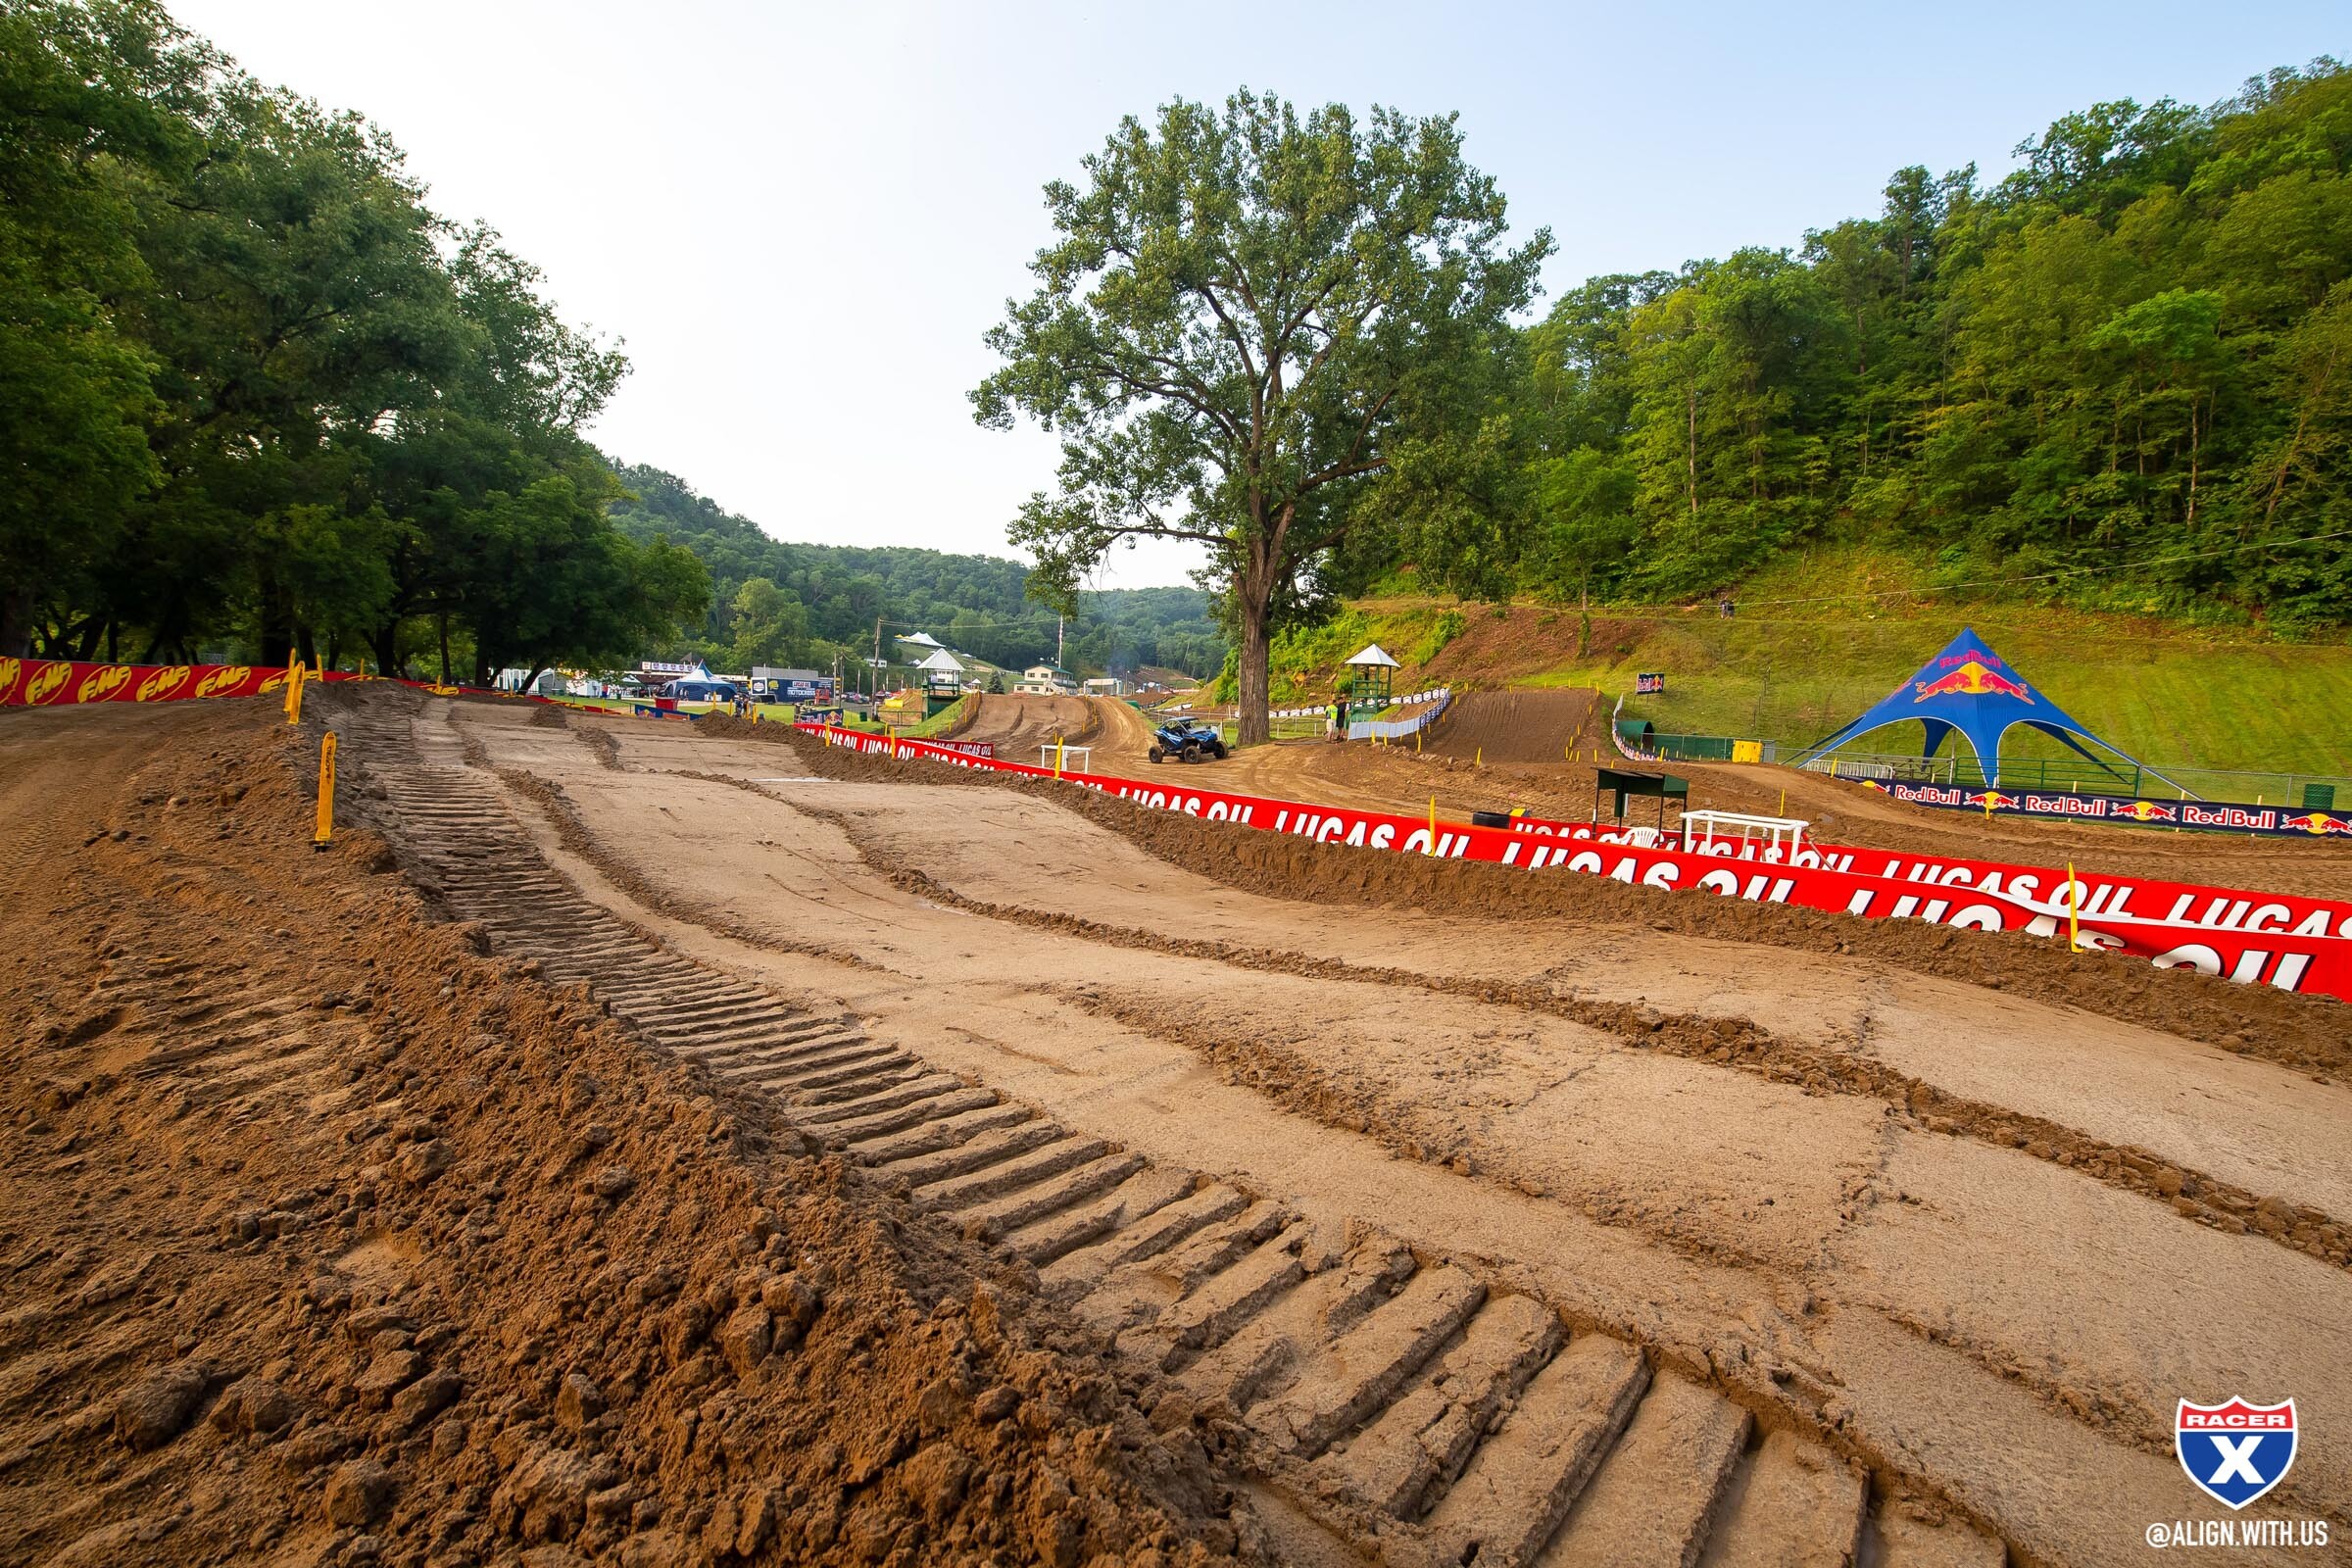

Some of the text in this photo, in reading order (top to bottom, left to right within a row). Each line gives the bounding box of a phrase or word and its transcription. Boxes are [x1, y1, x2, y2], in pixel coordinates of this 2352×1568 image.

[27, 662, 72, 705] FMF
[78, 665, 130, 704] FMF
[136, 666, 189, 702] FMF
[197, 666, 250, 698] FMF
[2048, 880, 2134, 918] OIL
[2165, 893, 2352, 939] LUCA
